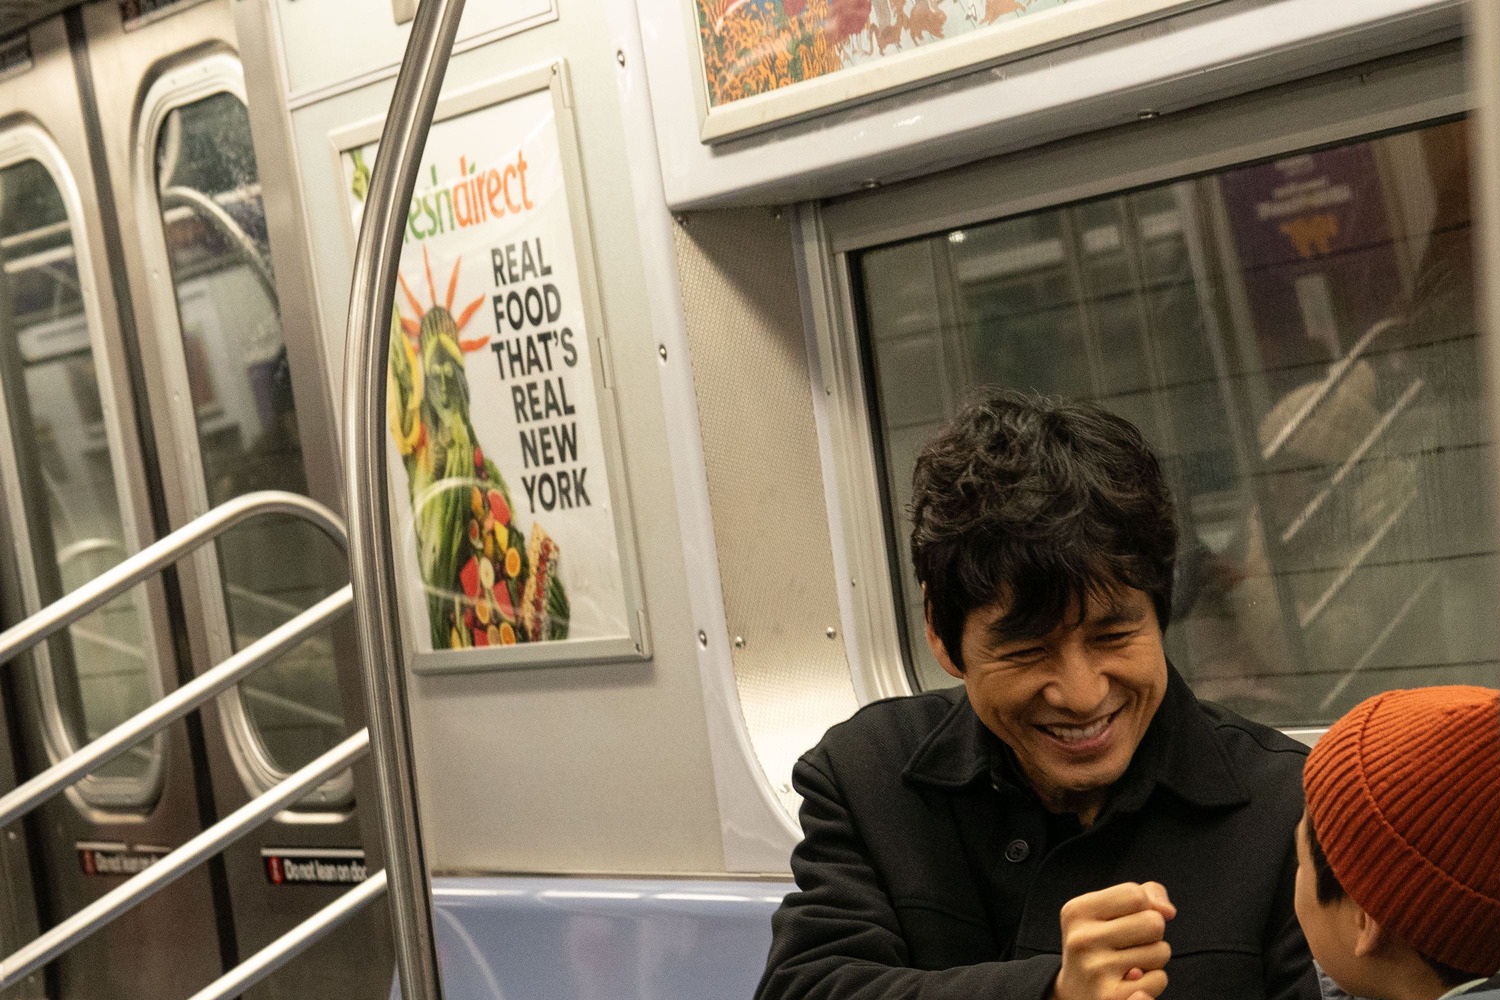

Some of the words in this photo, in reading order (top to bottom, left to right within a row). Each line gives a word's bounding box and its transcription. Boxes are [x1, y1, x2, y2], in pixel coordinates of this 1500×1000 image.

[404, 149, 534, 244] eshdirect
[491, 237, 552, 287] REAL
[492, 283, 562, 334] FOOD
[491, 327, 578, 380] THAT'S
[511, 377, 576, 424] REAL
[519, 422, 578, 469] NEW
[521, 467, 591, 514] YORK
[283, 858, 299, 880] Do
